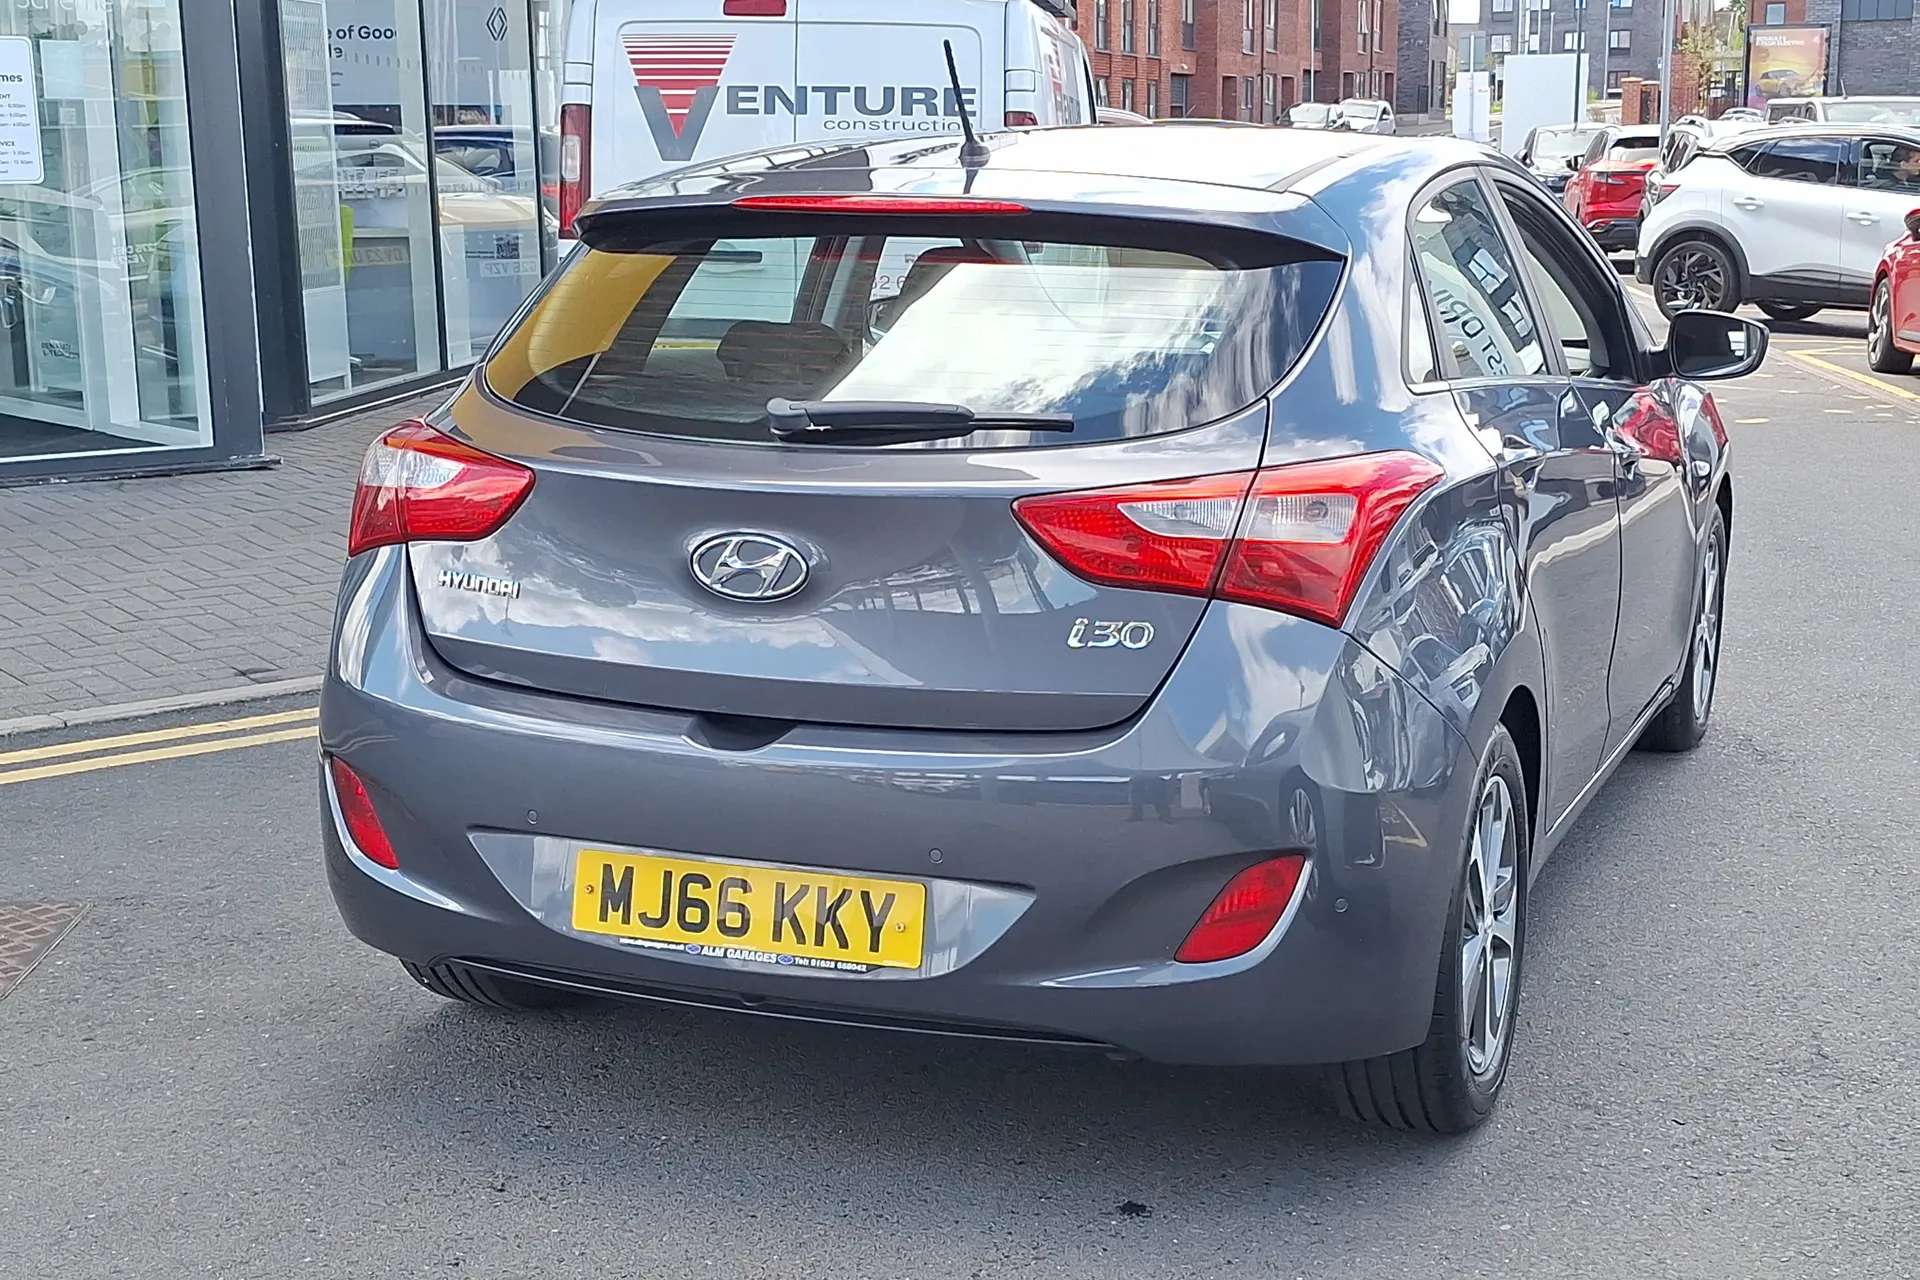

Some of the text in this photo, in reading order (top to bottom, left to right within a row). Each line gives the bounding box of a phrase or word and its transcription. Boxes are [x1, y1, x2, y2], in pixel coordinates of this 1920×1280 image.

[336, 25, 397, 39] of Goo
[823, 119, 973, 131] constructio
[438, 569, 521, 600] HYUNDAI
[1066, 617, 1155, 650] i30
[598, 863, 897, 954] MJ66 KKY
[701, 946, 725, 957] ALM
[726, 948, 778, 964] GARAGES
